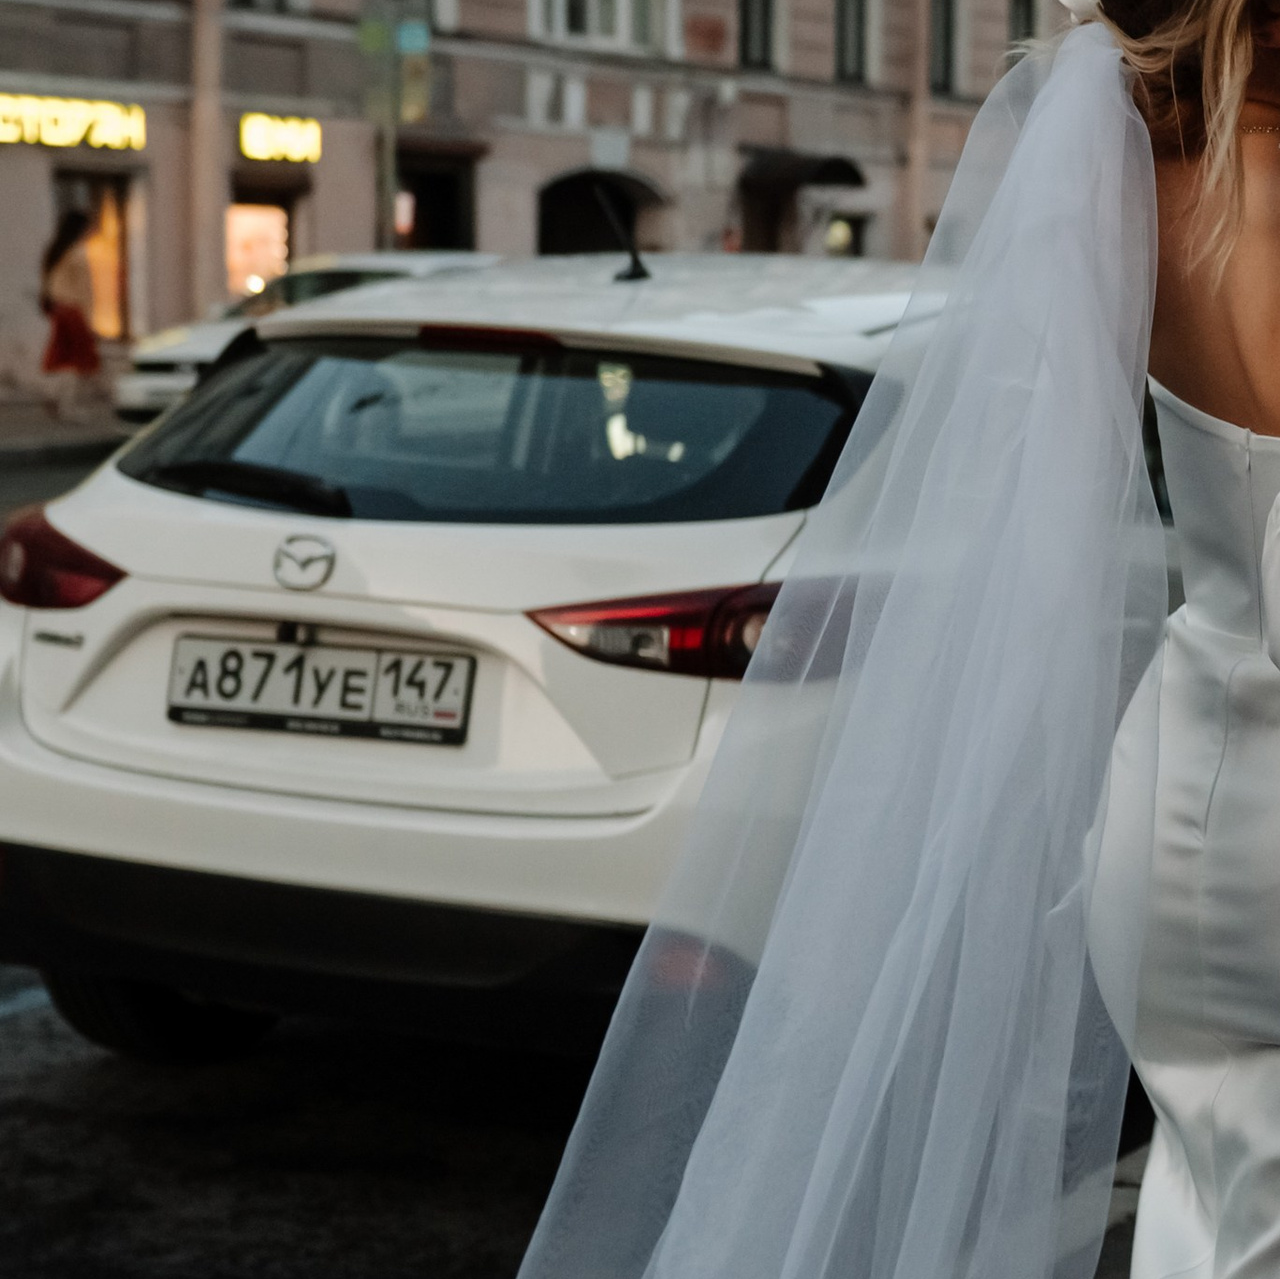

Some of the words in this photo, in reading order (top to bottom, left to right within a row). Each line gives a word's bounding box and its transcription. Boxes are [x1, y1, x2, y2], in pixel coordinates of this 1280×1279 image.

[185, 649, 367, 711] А871УЕ
[383, 656, 454, 701] 147
[394, 701, 430, 717] RUS
